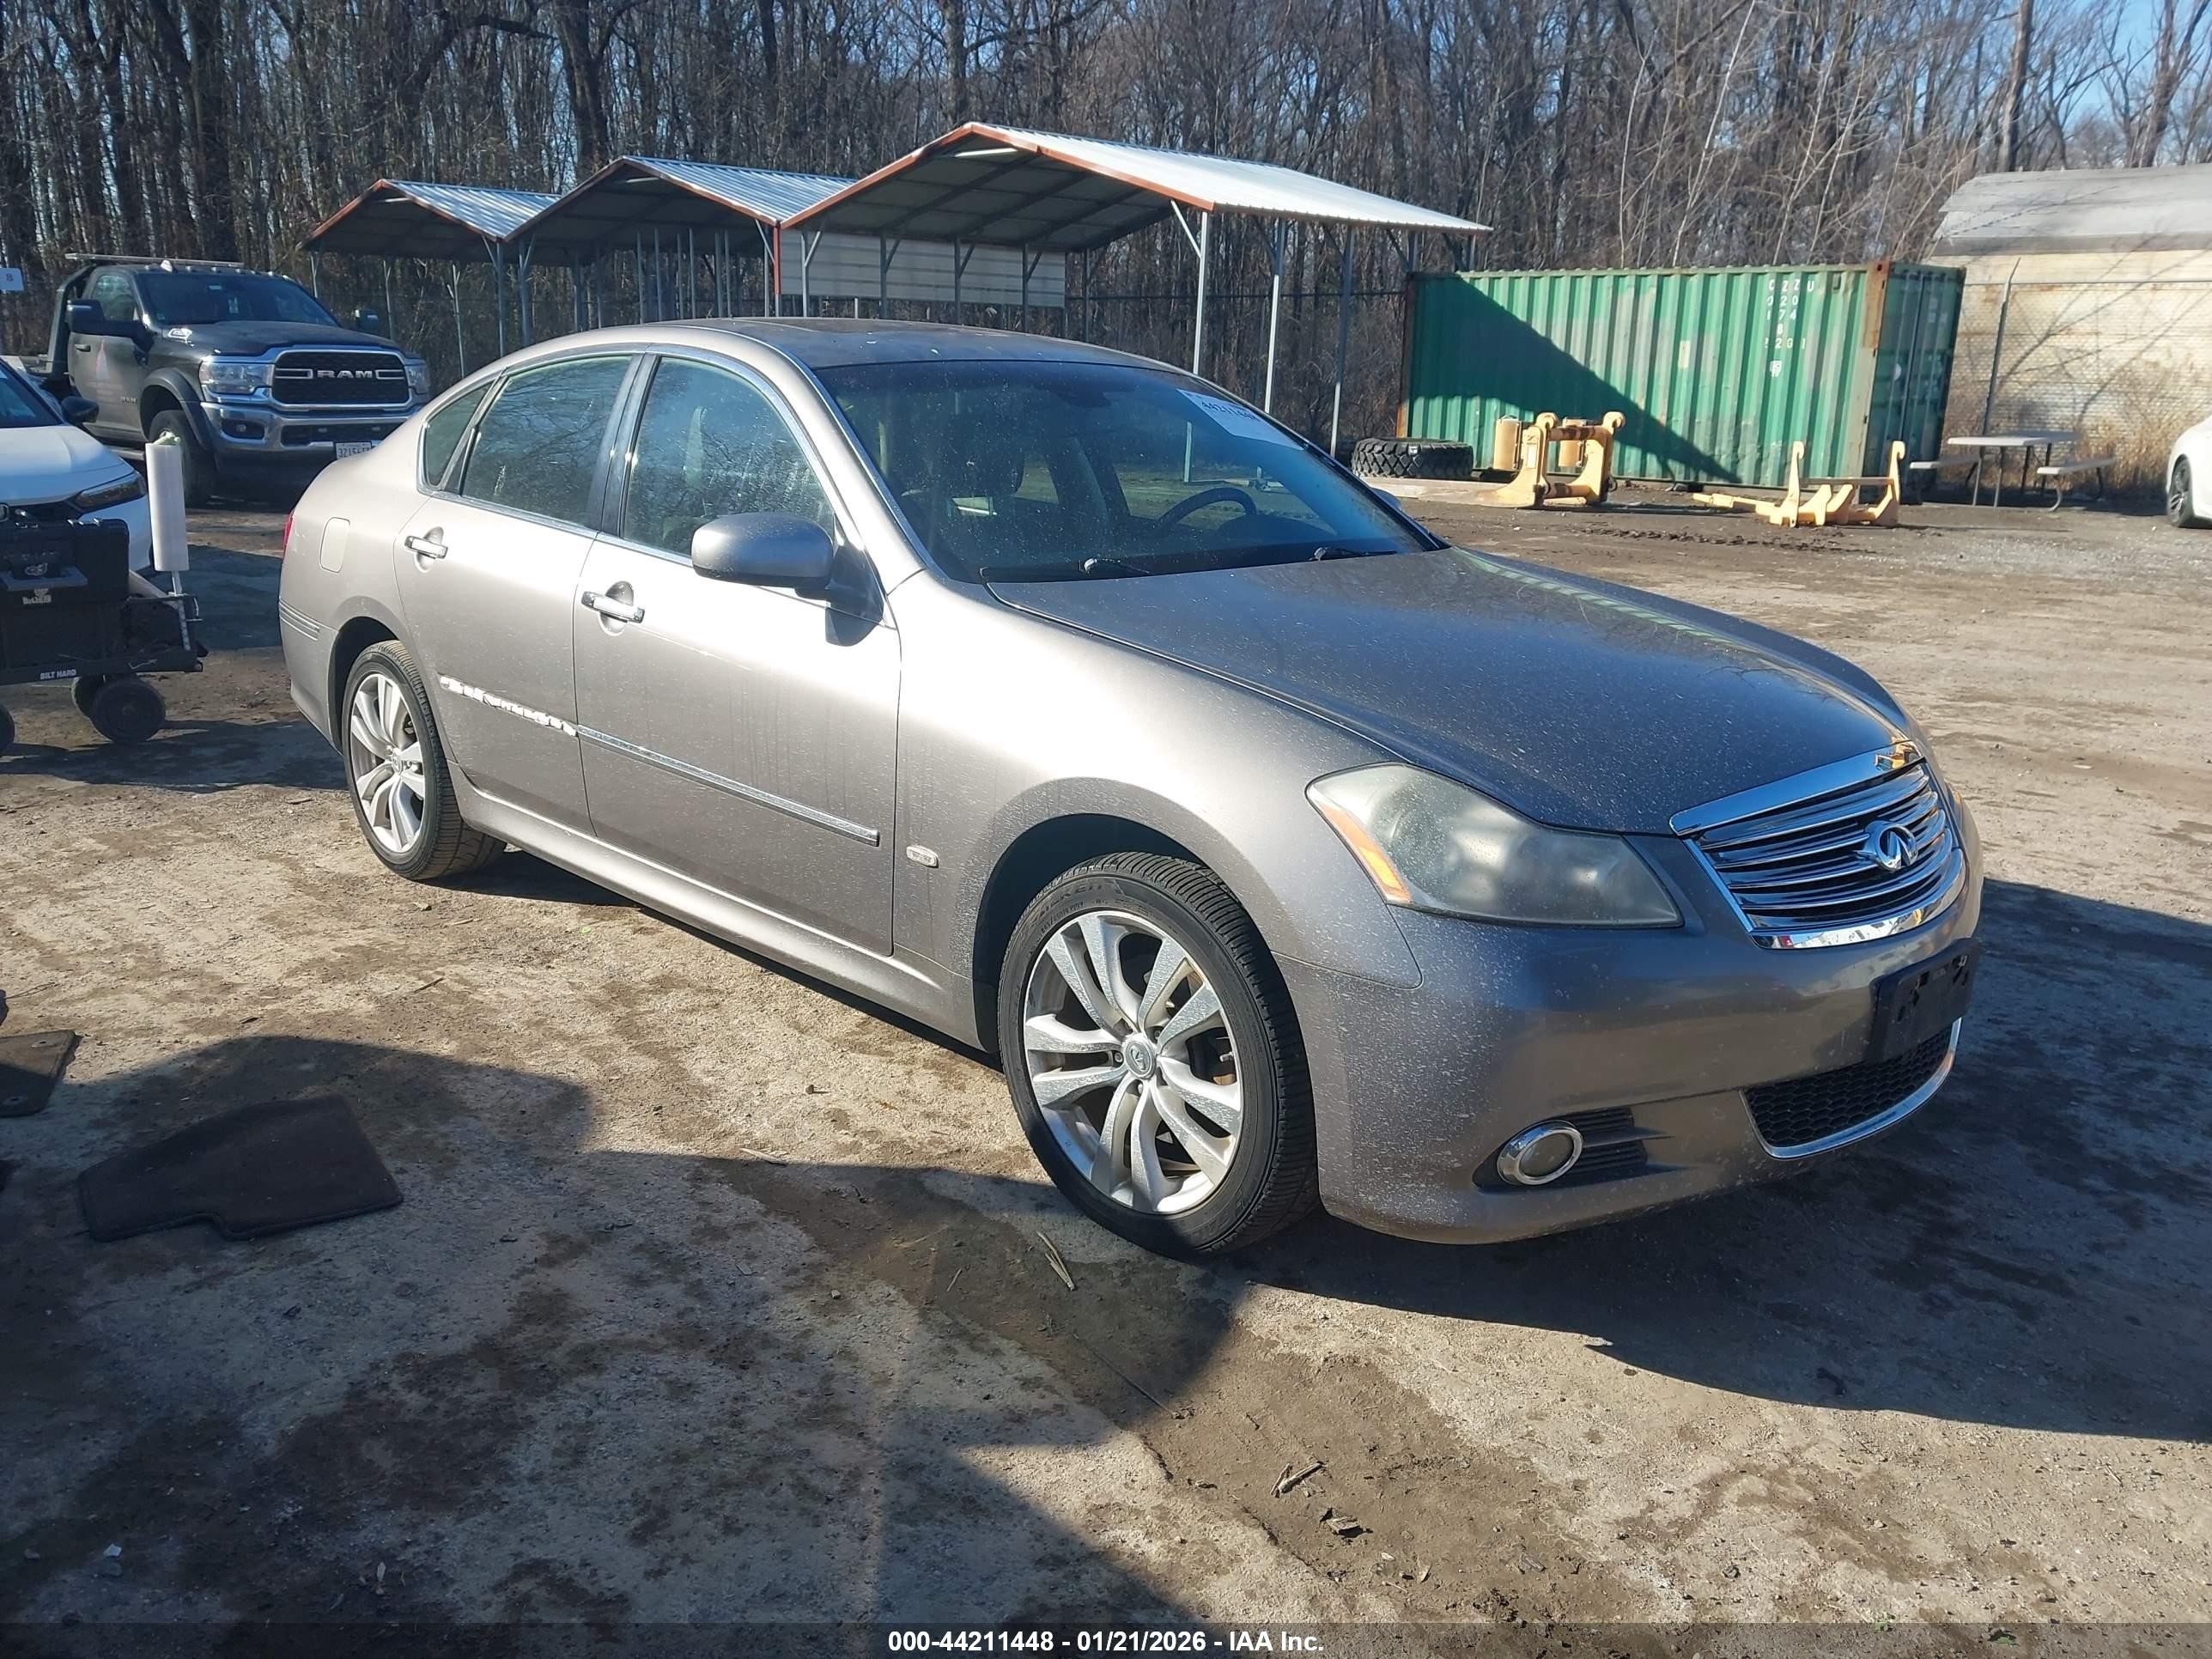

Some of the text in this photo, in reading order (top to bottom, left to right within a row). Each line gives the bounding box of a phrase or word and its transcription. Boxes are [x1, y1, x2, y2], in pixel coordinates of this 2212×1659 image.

[1766, 295, 1799, 307] 020
[1766, 308, 1796, 320] 174
[317, 370, 373, 379] RAM
[57, 669, 76, 678] HARD
